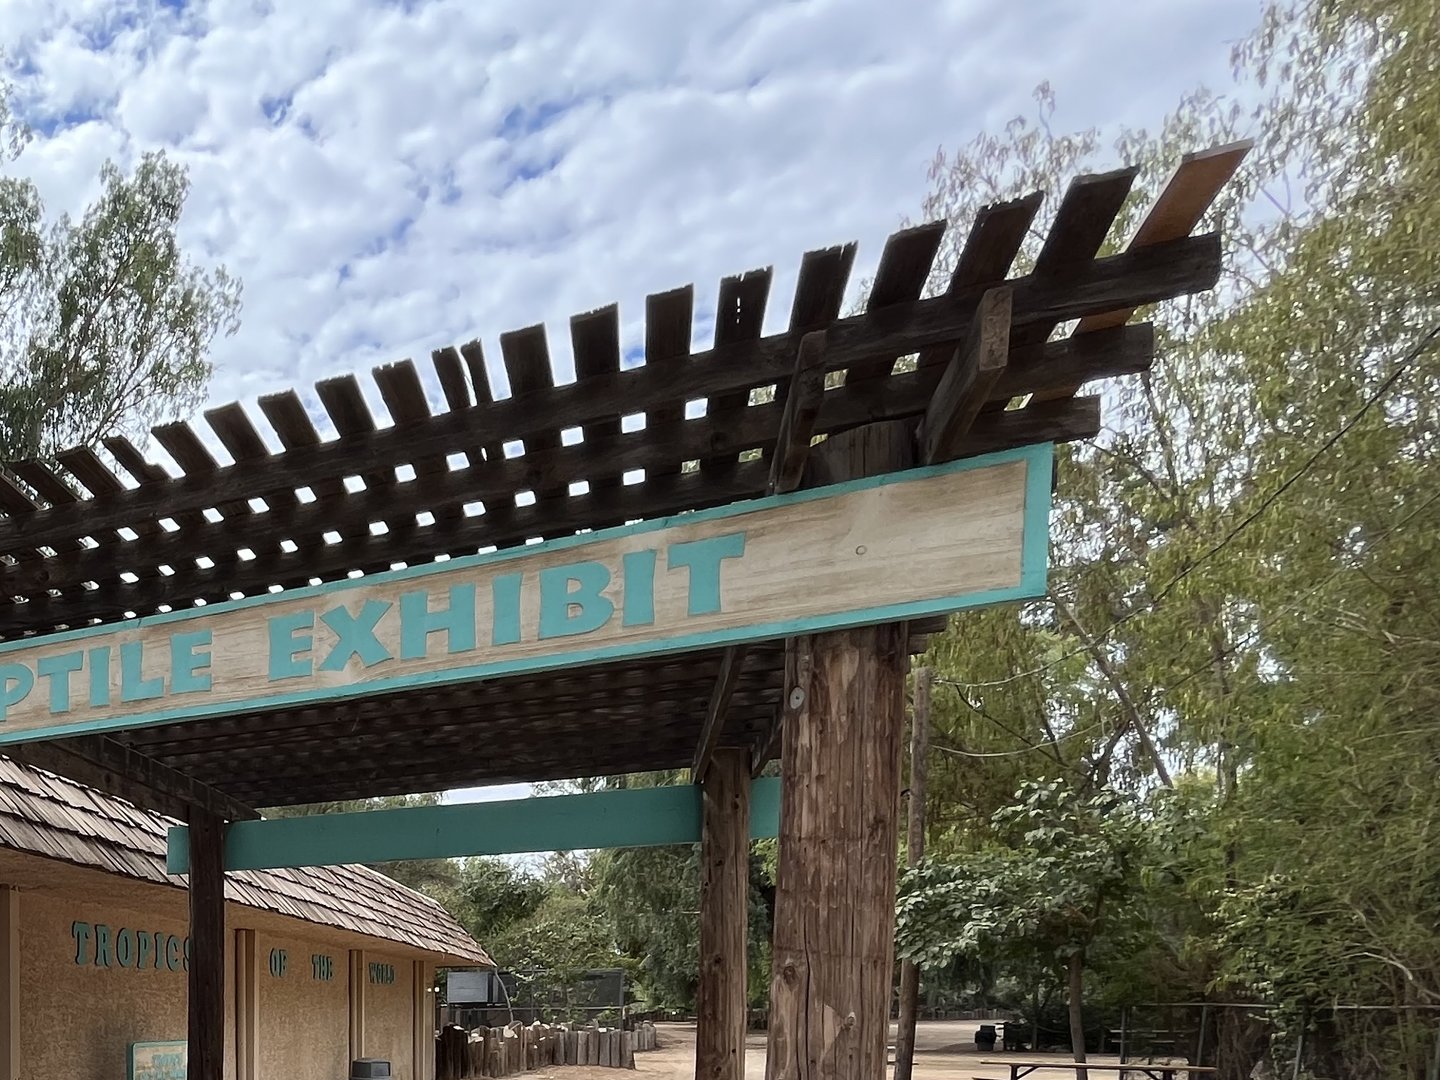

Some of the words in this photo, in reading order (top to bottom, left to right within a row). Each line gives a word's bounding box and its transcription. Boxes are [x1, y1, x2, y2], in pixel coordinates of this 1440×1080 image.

[267, 531, 747, 683] EXHIBIT
[269, 948, 288, 978] OF
[311, 953, 334, 982] THE
